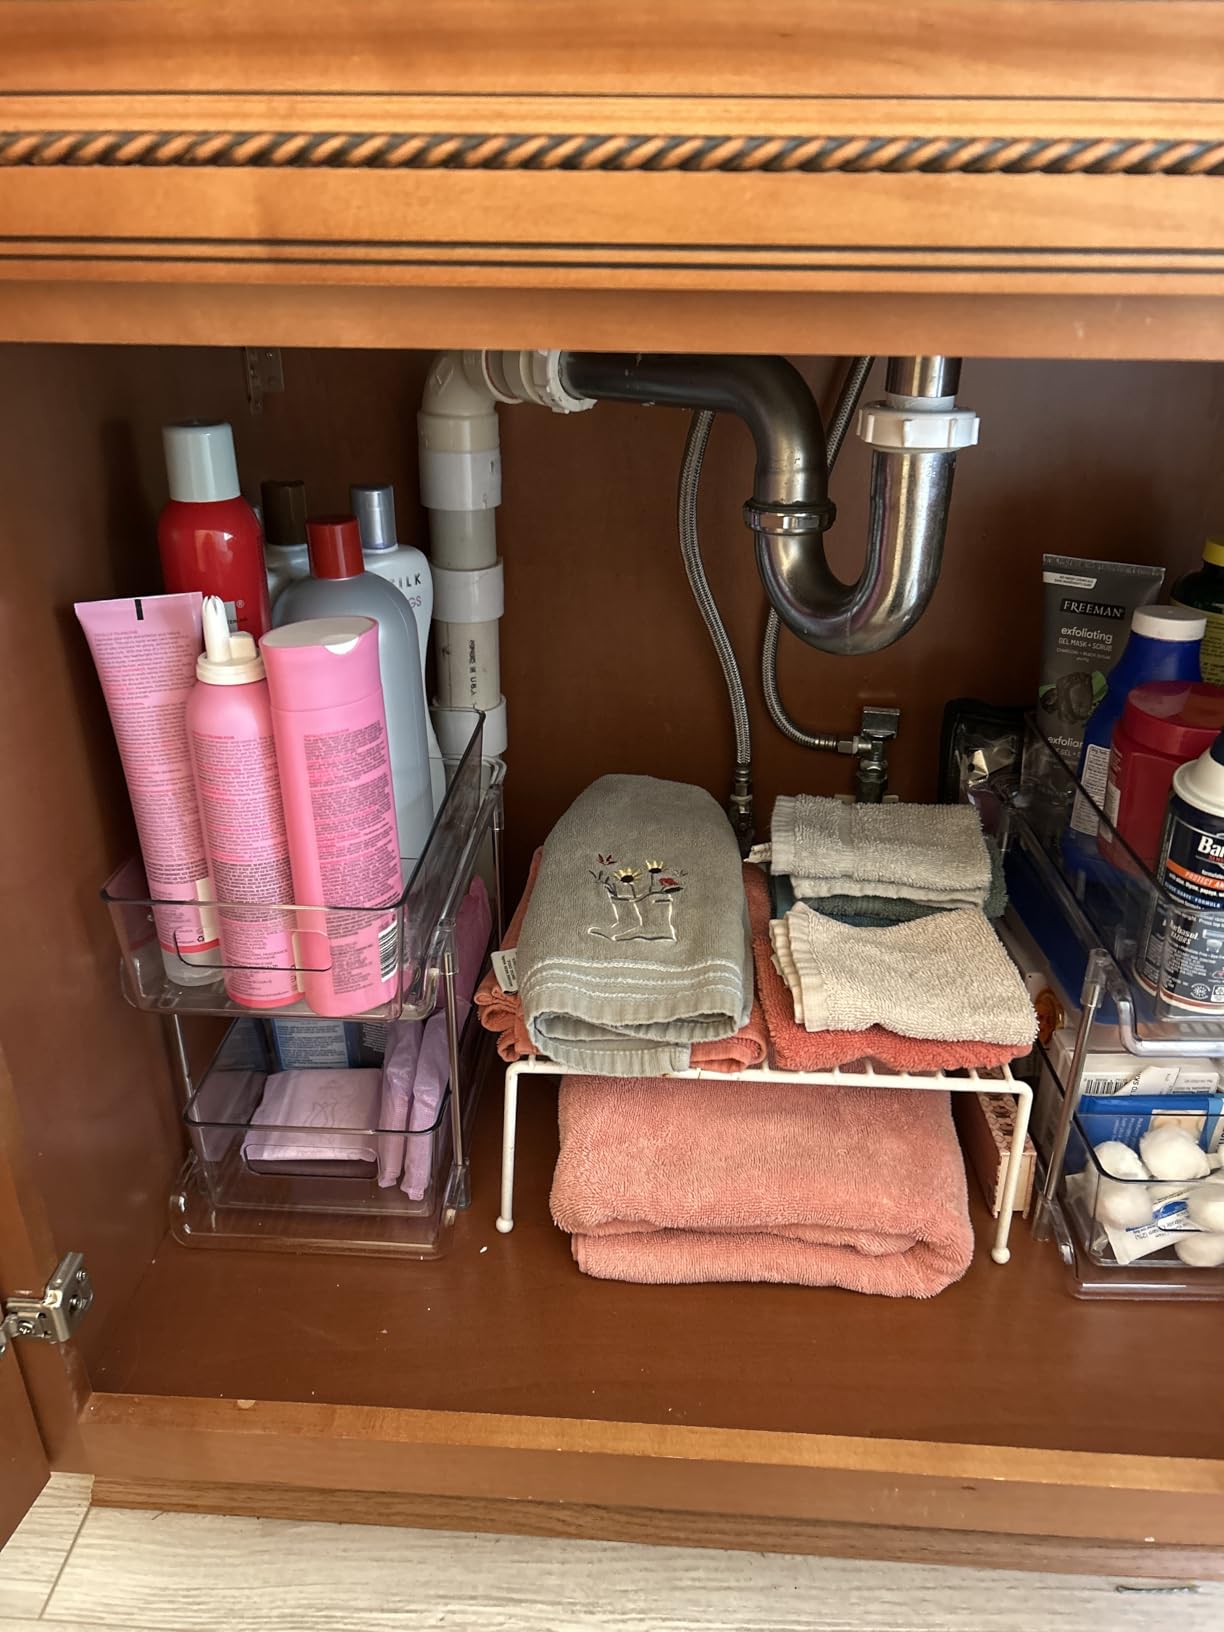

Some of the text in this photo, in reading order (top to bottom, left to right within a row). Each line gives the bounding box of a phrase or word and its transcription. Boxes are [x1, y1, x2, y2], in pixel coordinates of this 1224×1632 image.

[1063, 600, 1121, 617] FREEMAN
[1061, 626, 1113, 645] exfoliating
[1194, 897, 1221, 908] FORMULA
